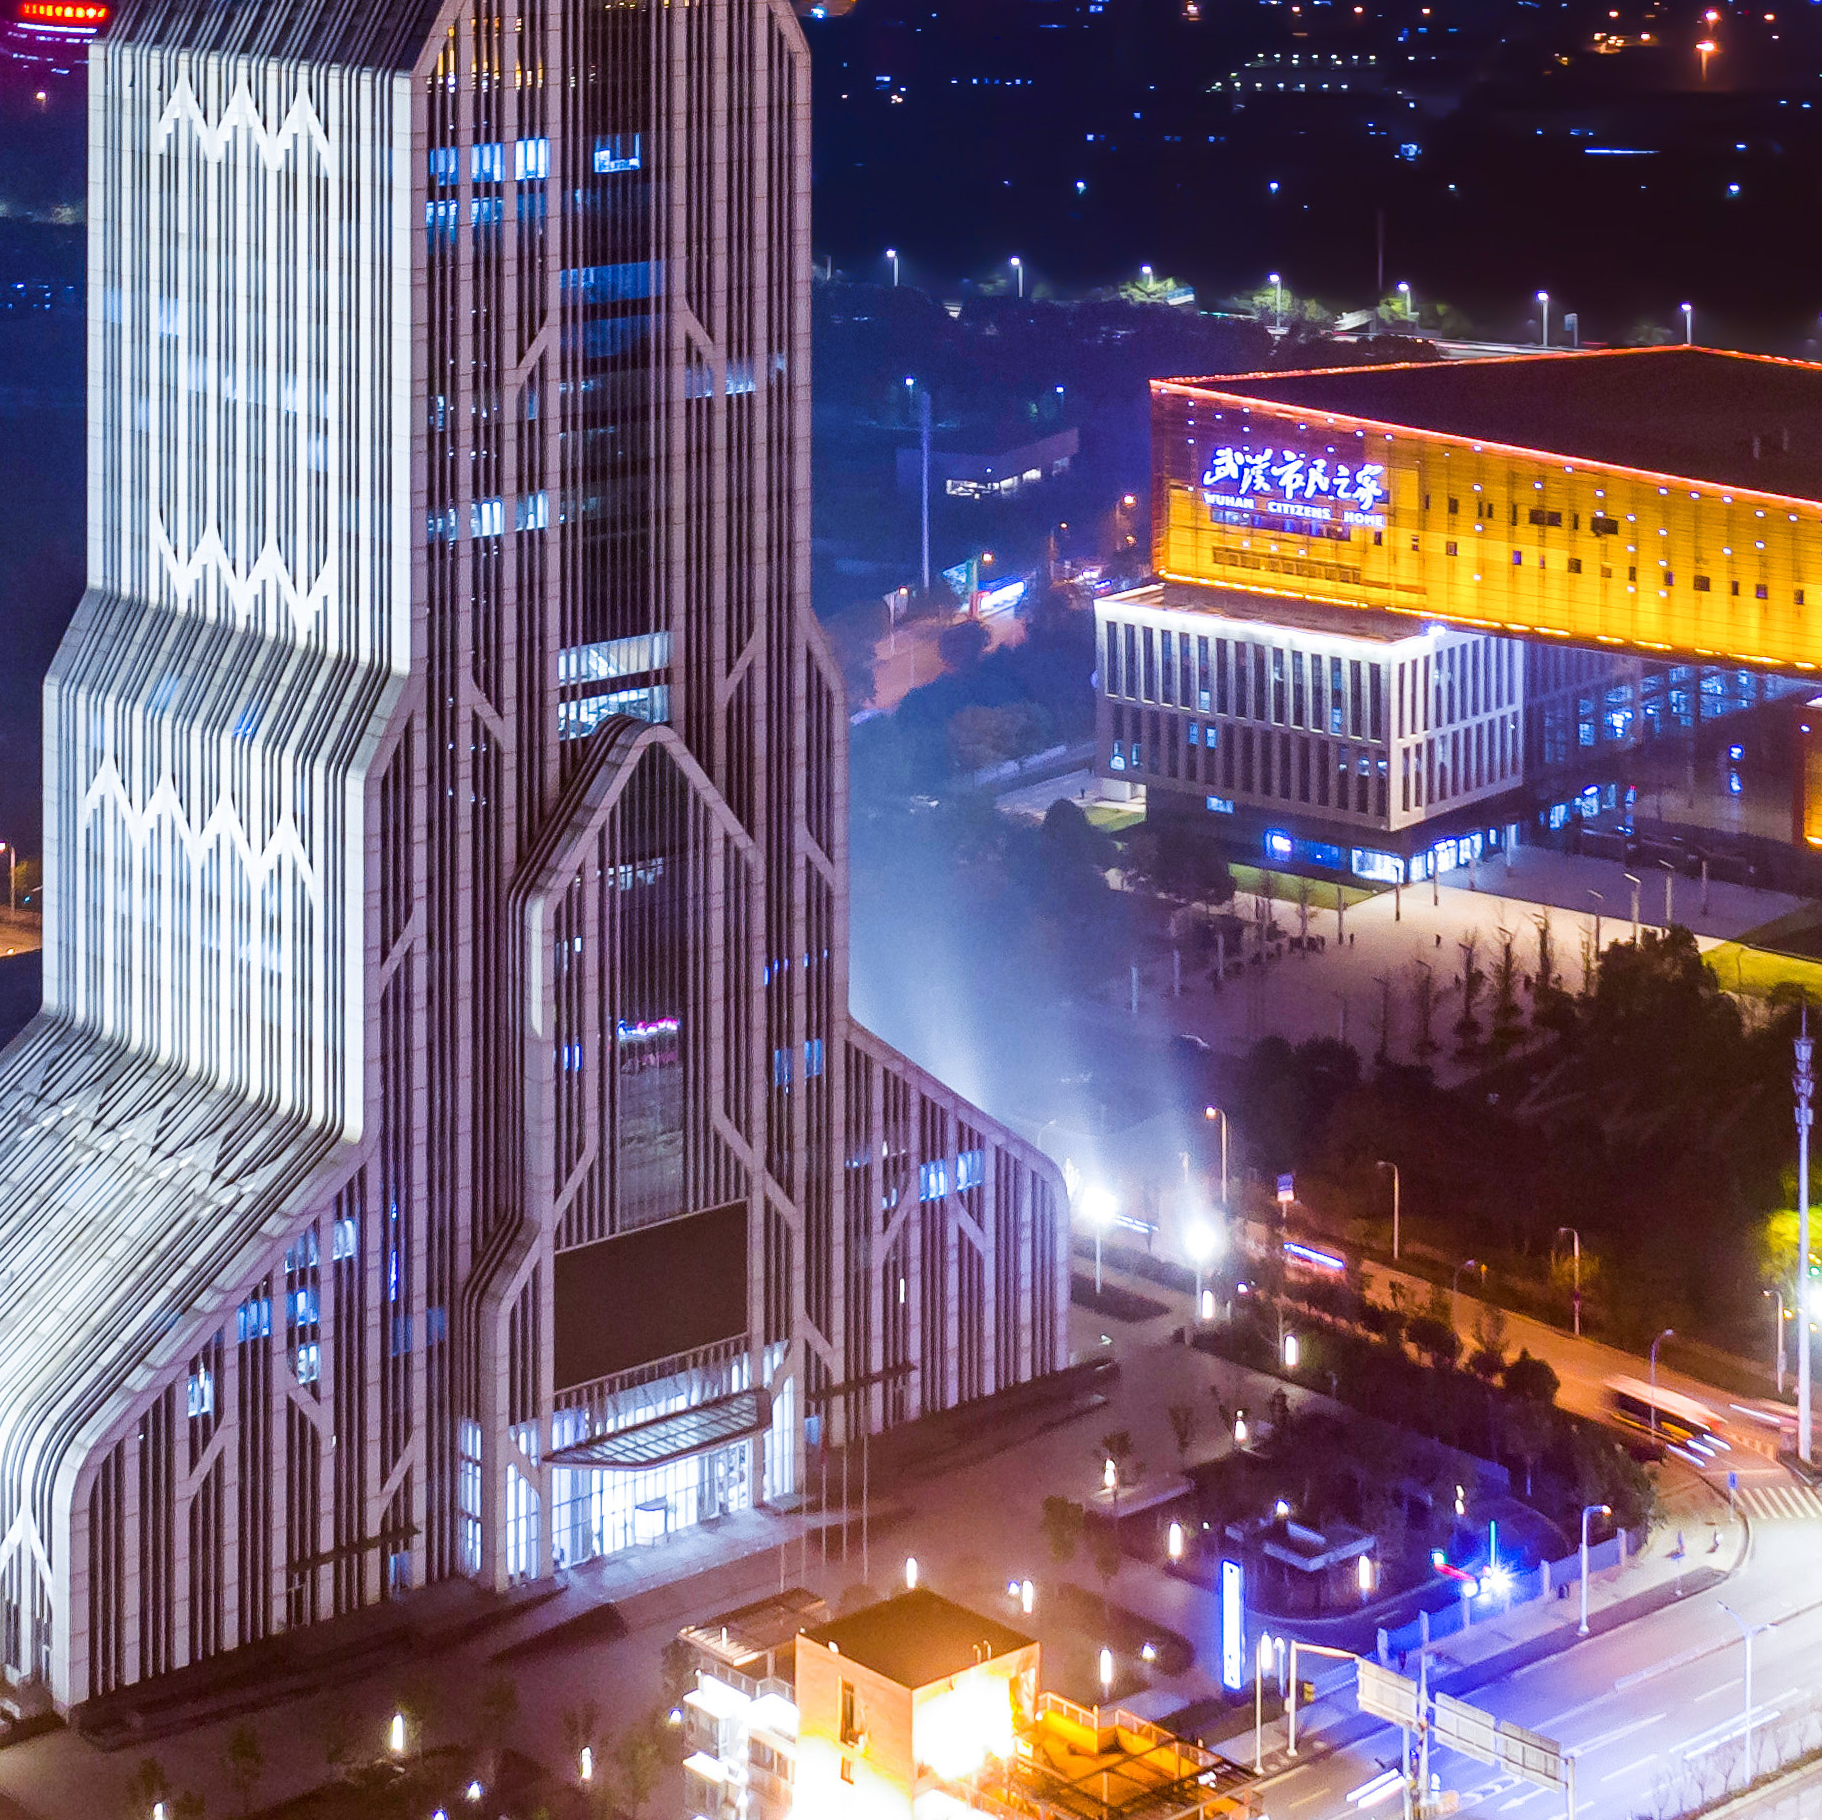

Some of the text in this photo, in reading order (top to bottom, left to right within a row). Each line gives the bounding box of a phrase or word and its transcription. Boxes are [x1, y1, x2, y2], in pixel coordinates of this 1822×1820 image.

[1203, 491, 1385, 527] WUHAN CITIZENS HOME
